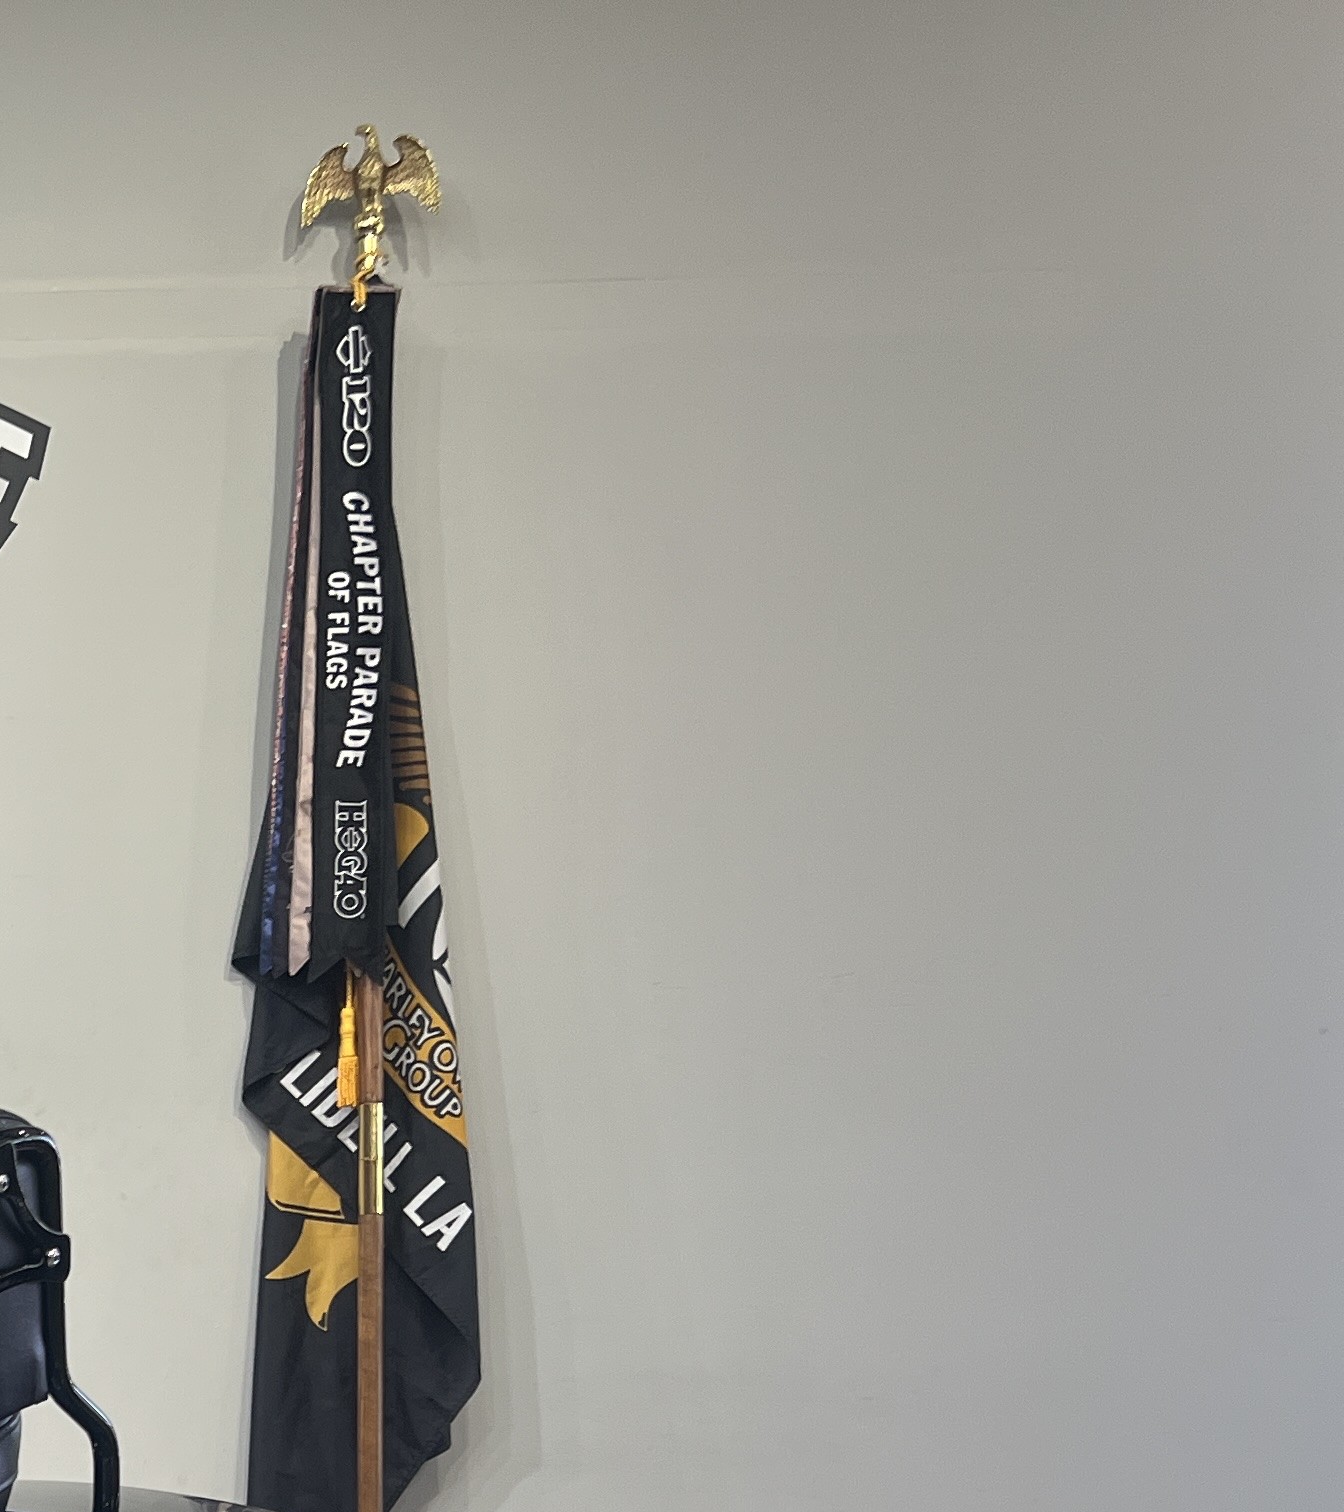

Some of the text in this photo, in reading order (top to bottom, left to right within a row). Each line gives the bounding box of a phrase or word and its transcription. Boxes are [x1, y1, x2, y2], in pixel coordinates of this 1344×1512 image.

[341, 374, 372, 467] 120
[325, 571, 351, 690] OF FLAGS
[336, 490, 384, 768] CHAPTER PARADE
[382, 953, 444, 1047] ARLEY
[382, 1018, 462, 1117] GROUP
[403, 1174, 473, 1252] LA
